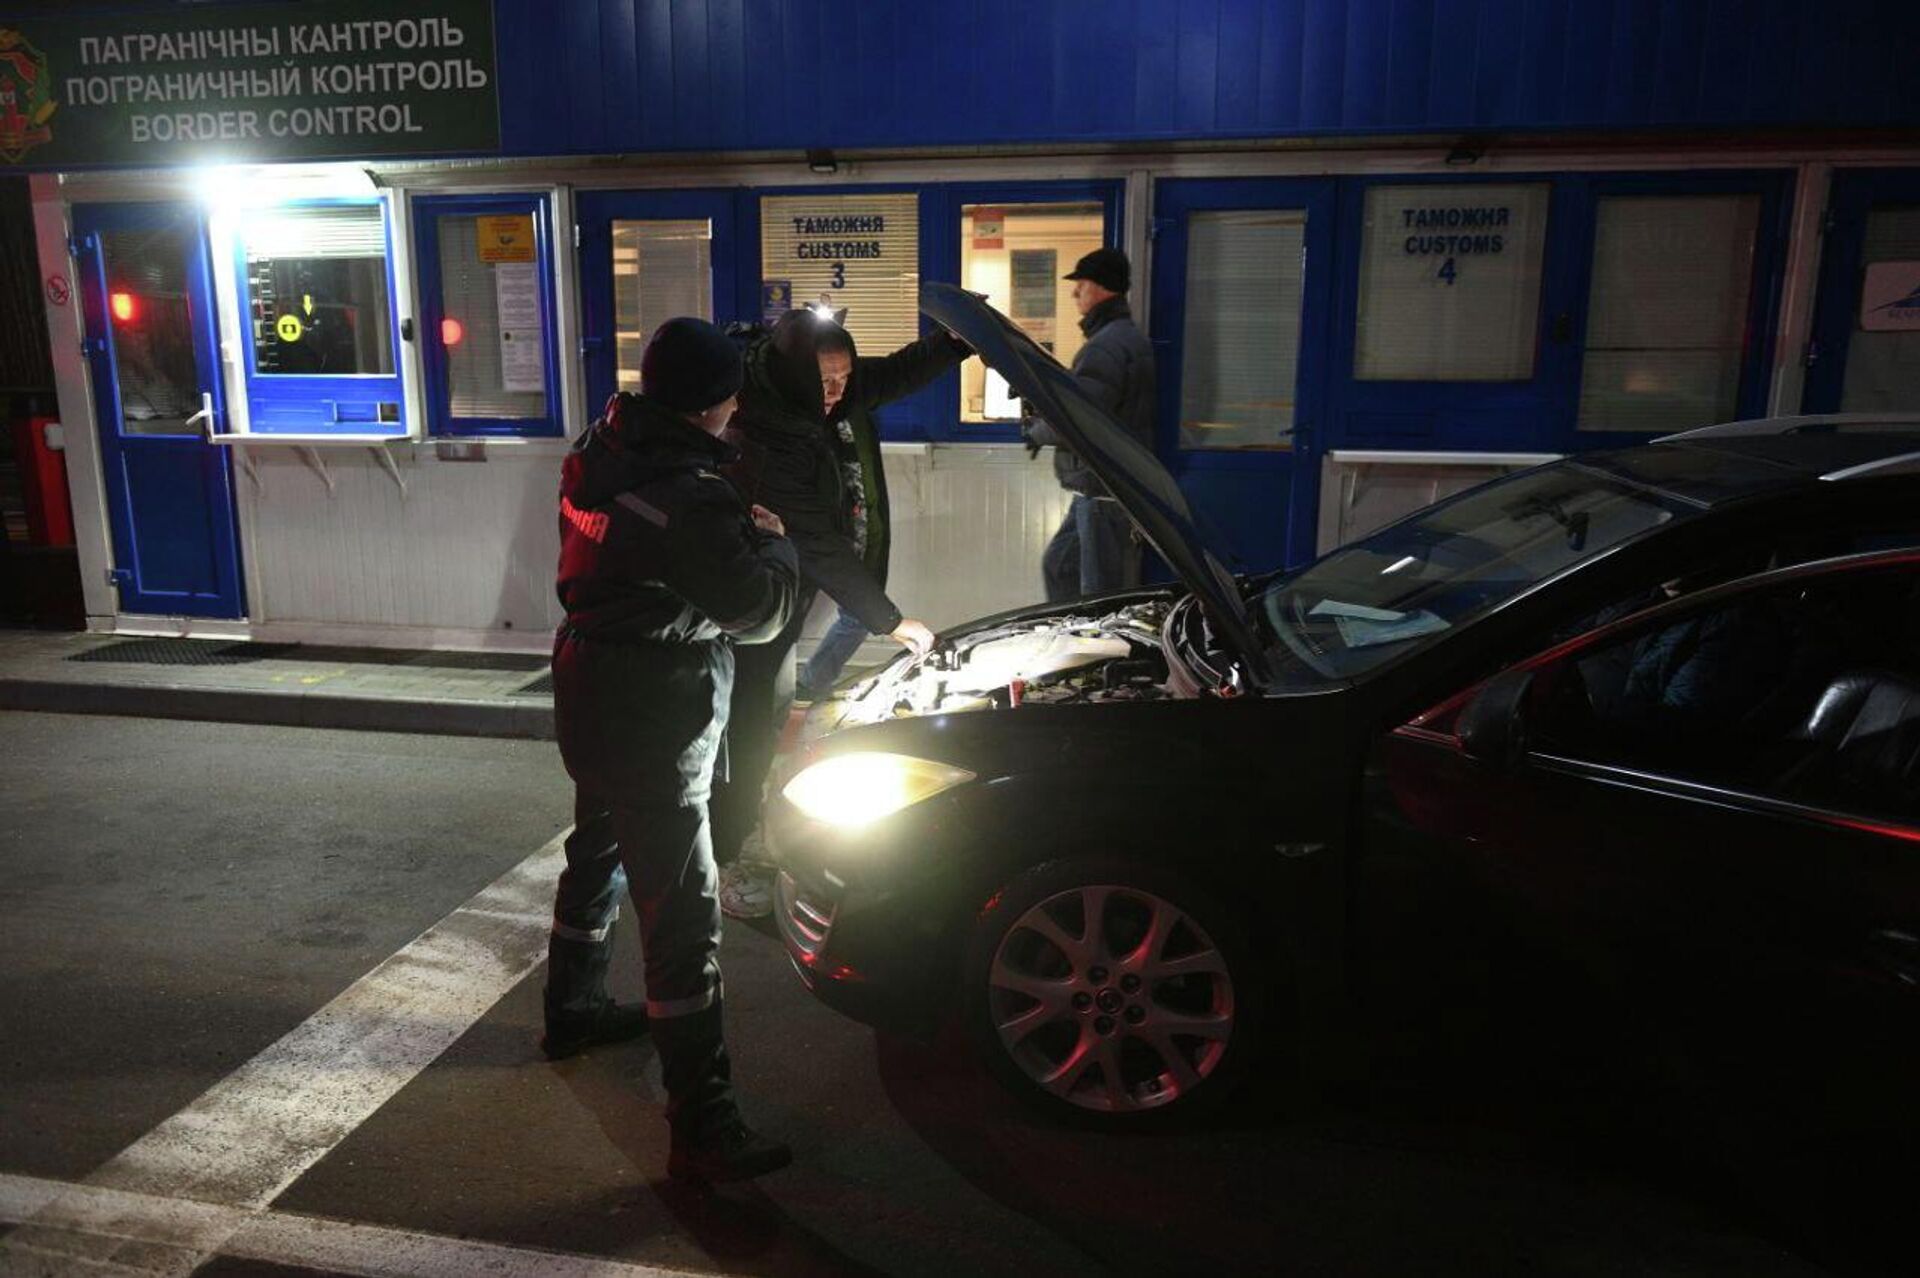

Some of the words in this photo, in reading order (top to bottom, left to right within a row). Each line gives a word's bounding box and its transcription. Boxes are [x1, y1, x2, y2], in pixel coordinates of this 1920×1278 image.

[80, 26, 280, 65] ПАГРАНІЧНЫ
[289, 17, 464, 54] КАНТРОЛЬ
[66, 60, 300, 106] ПОГРАНИЧНЫЙ
[311, 58, 487, 94] КОНТРОЛЬ
[131, 110, 261, 142] BORDER
[268, 103, 423, 137] CONTROL
[793, 216, 884, 234] ТАМОЖНЯ
[1402, 207, 1509, 227] ТАМОЖНЯ
[798, 242, 881, 259] CUSTOMS
[1405, 235, 1503, 254] CUSTOMS
[831, 261, 845, 289] 3
[1438, 257, 1457, 285] 4
